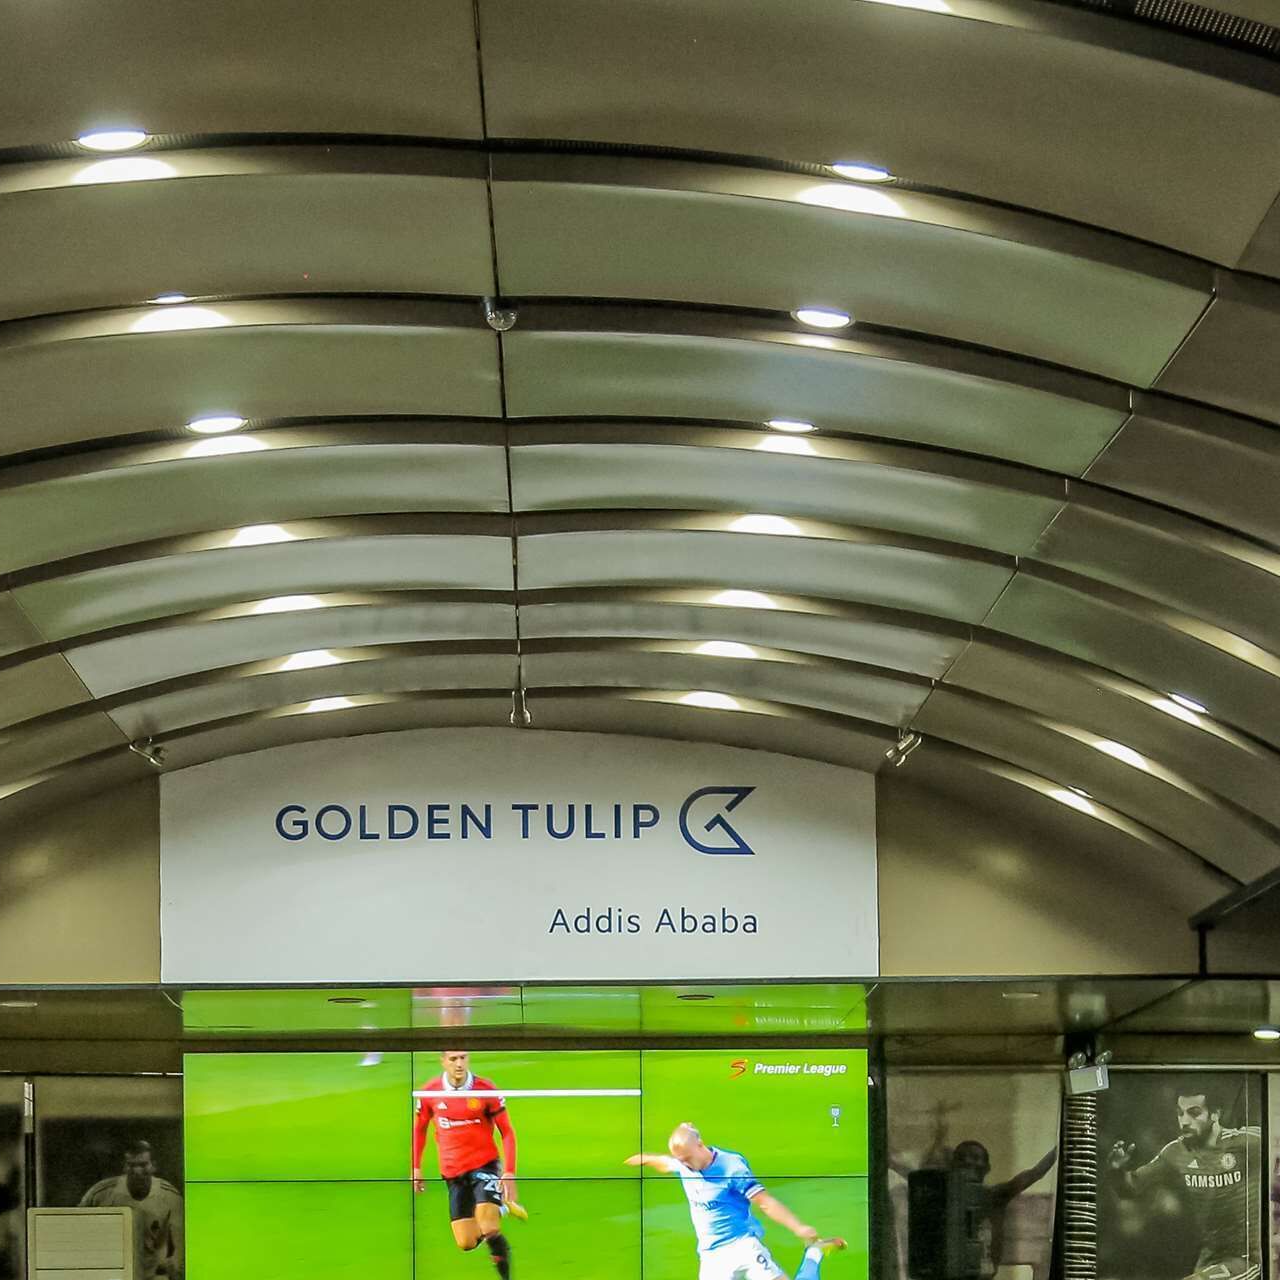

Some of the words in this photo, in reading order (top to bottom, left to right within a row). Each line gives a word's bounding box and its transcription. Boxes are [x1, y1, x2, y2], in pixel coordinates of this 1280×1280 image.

[275, 803, 493, 841] GOLDEN
[511, 803, 662, 840] TULIP
[548, 907, 642, 936] Addis
[654, 907, 760, 936] Ababa
[754, 1062, 801, 1075] Premier
[803, 1063, 847, 1077] League
[1184, 1171, 1241, 1188] SAMSUNG
